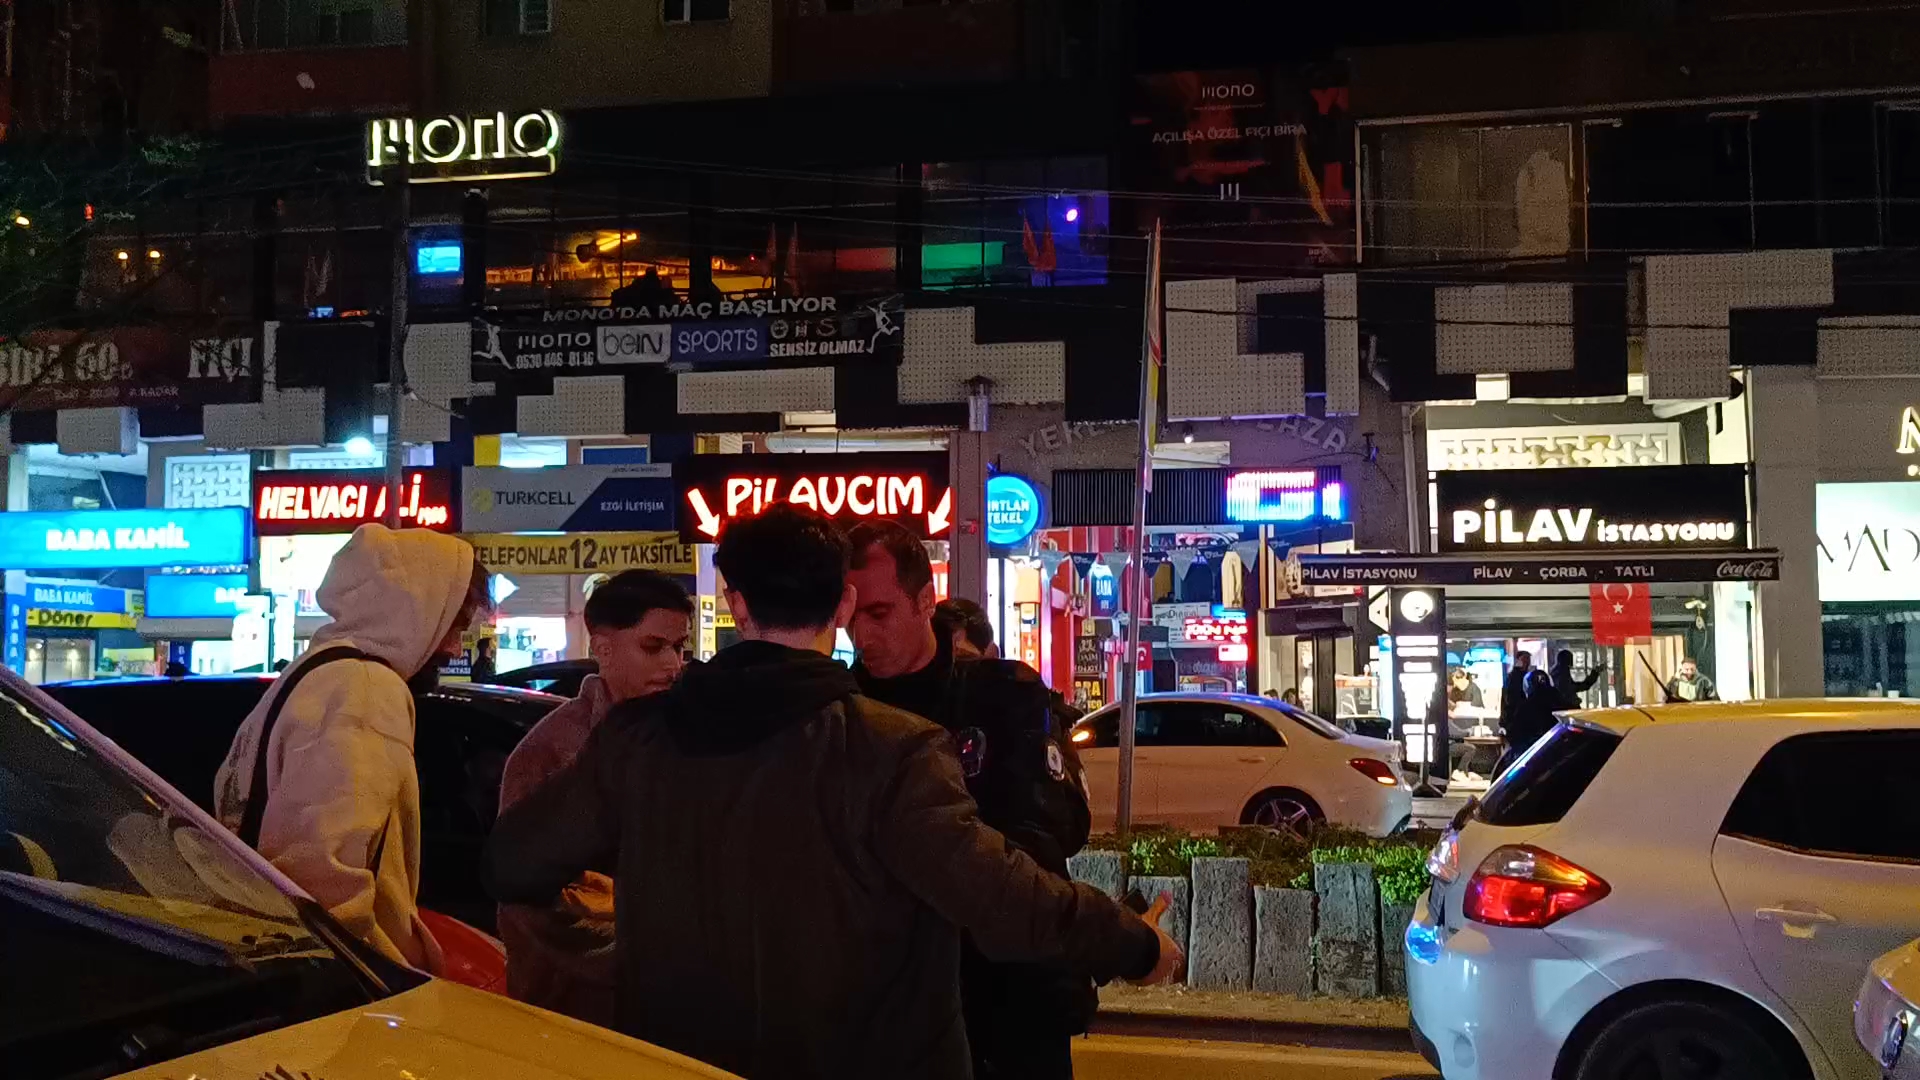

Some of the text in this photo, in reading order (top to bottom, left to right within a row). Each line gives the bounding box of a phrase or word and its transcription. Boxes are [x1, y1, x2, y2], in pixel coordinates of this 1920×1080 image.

[1208, 126, 1241, 140] ÖZEL
[543, 297, 837, 322] MONO'DA MAÇ BAŞLIYOR
[678, 328, 758, 354] SPORTS
[770, 340, 866, 358] SENSİZ OLMAZ
[260, 485, 368, 519] HELVACI
[496, 491, 576, 505] TURKCELL
[46, 522, 190, 550] BABA KAMİL
[570, 538, 599, 569] 12
[600, 546, 616, 565] AY
[1302, 566, 1417, 579] PİLAV İSTASYONU
[1473, 565, 1513, 579] PİLAV
[1540, 565, 1588, 580] ÇORBA
[1615, 564, 1655, 577] TATLI
[34, 588, 94, 606] BABA KAMİL
[38, 610, 93, 626] Döner
